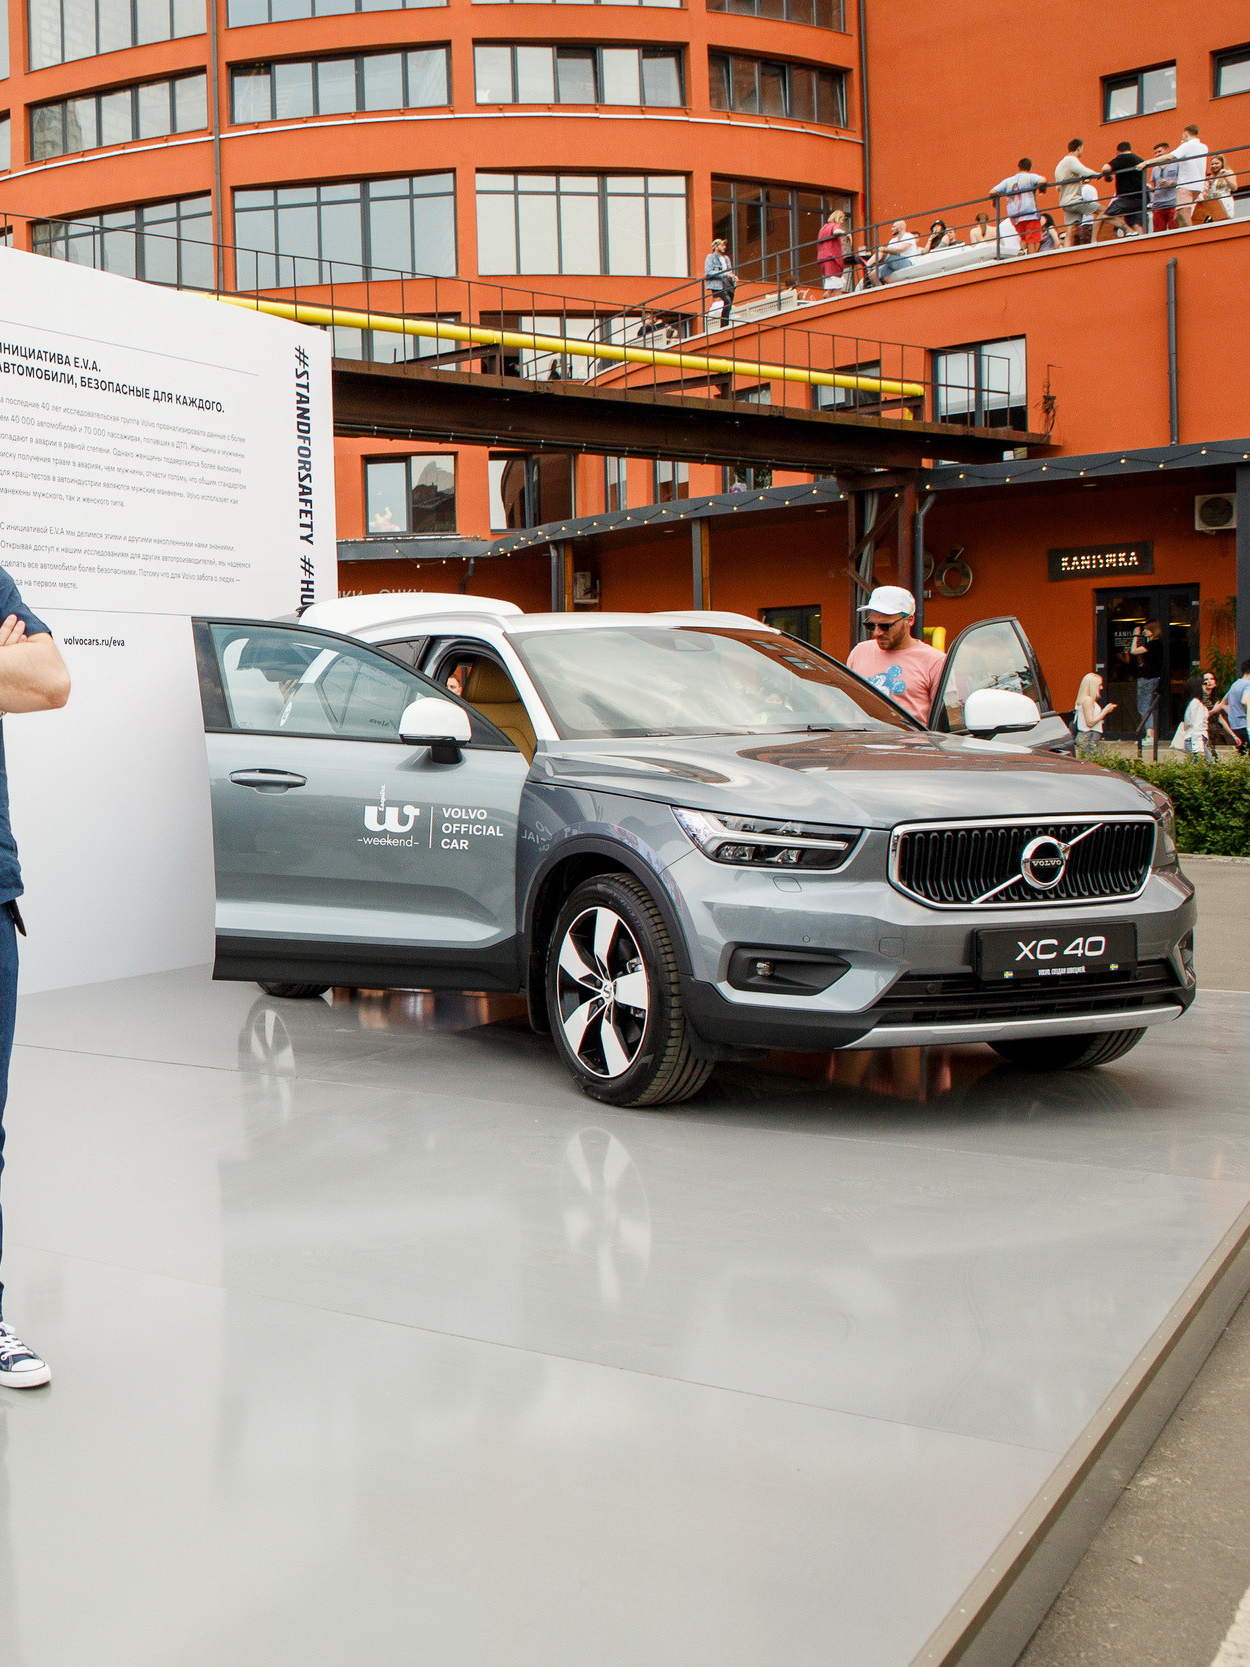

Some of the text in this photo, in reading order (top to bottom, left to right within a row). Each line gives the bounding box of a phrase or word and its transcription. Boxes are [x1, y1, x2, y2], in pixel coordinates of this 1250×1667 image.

[74, 356, 101, 372] E.V.A.
[80, 376, 151, 399] БЕЗОПАСНЫЕ
[153, 389, 173, 404] ДЛЯ
[175, 393, 225, 413] КАЖДОГО.
[5, 398, 40, 409] последние
[11, 415, 20, 423] 40
[22, 416, 36, 426] 000
[294, 345, 314, 545] #STANDFORSAFETY
[17, 454, 51, 463] получения
[0, 540, 33, 551] Открывая
[0, 560, 27, 569] сделать
[63, 636, 125, 648] volvocars.ru/eva
[442, 807, 488, 820] VOLVO
[441, 822, 504, 837] OFFICIAL
[441, 838, 469, 850] CAR
[1032, 859, 1062, 867] VOLVO
